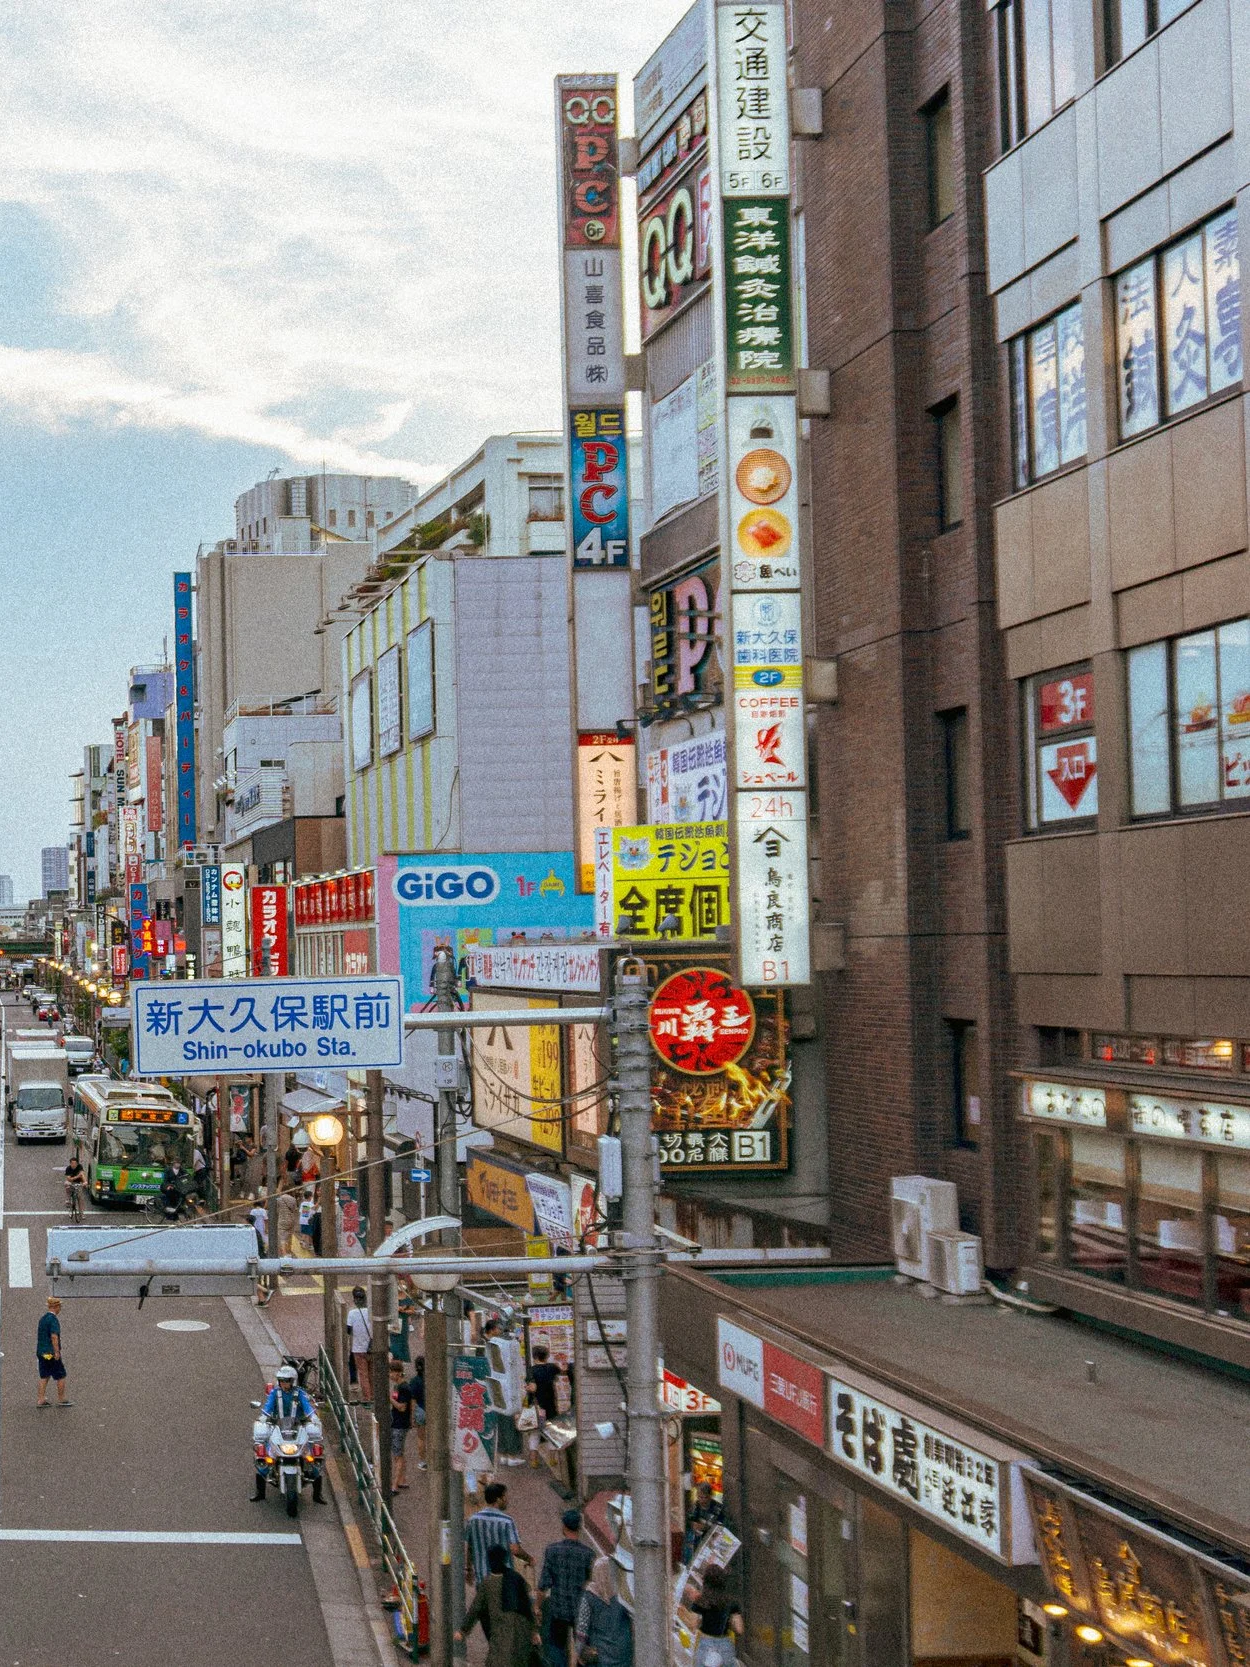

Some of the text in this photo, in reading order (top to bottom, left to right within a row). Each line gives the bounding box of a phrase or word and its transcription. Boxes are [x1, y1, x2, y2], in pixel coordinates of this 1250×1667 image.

[734, 8, 772, 162] 交通建設
[565, 96, 616, 125] QQ
[574, 135, 609, 213] PC
[729, 171, 783, 188] 5F 6F
[586, 223, 605, 239] 6F
[641, 187, 694, 311] QQ
[734, 206, 783, 370] 東洋鍼灸治療院
[574, 412, 624, 438] 월드
[580, 441, 619, 525] PC
[576, 527, 627, 565] 4F
[759, 565, 797, 579] 魚べい
[736, 630, 799, 645] 新大久保
[737, 649, 800, 664] 歯科医院
[759, 671, 778, 684] 2F
[739, 697, 799, 708] COFFEE
[1058, 680, 1087, 723] 3F
[116, 732, 124, 763] HOTEL
[116, 769, 124, 793] SUN
[742, 771, 799, 783] シュベール
[1061, 755, 1086, 782] 入口
[751, 796, 793, 818] 24h
[397, 873, 495, 900] GiGO
[516, 875, 537, 897] 1F
[598, 832, 610, 937] エレベーター有
[616, 885, 729, 938] 全席個
[765, 867, 785, 952] 鳥良商店
[763, 960, 790, 982] B1
[146, 992, 391, 1036] 新大久保駅前
[183, 1036, 357, 1061] Shin-okubo Sta.
[739, 1136, 767, 1158] B1
[736, 1354, 759, 1382] MUFG
[686, 1390, 710, 1411] 3F
